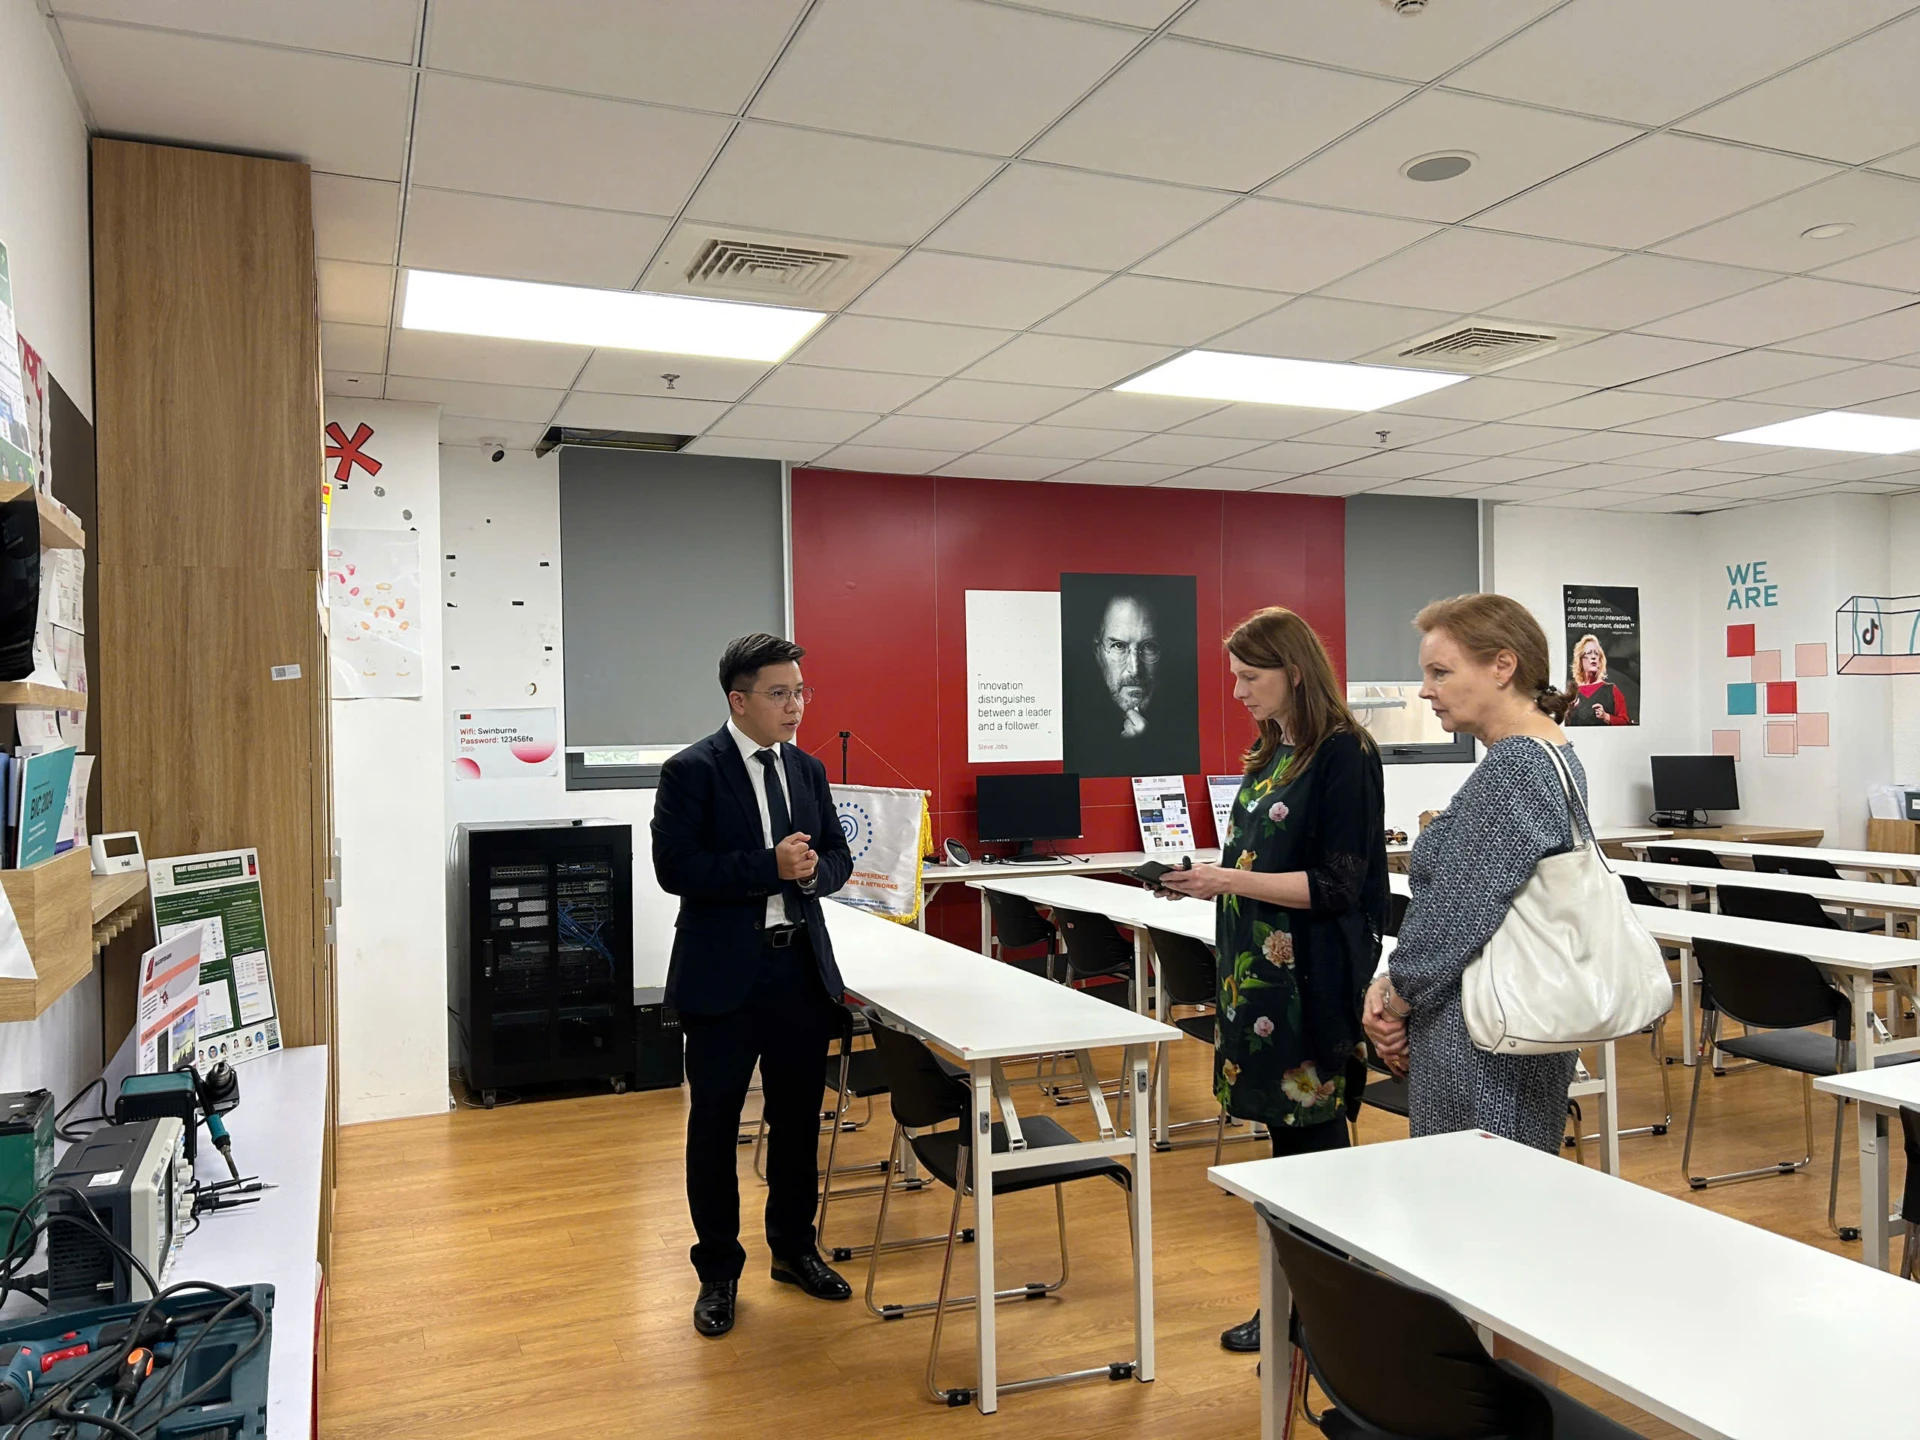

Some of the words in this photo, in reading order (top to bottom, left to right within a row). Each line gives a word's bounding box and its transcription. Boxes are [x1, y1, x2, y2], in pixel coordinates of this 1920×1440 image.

[1726, 561, 1767, 586] WE
[1727, 585, 1778, 610] ARE
[978, 680, 1023, 690] Innovation
[978, 694, 1036, 705] distinguishes
[978, 708, 1015, 717] between
[1026, 708, 1052, 717] leader
[978, 722, 994, 731] and
[1005, 722, 1040, 730] follower.
[852, 872, 889, 880] CONFERENCE
[866, 881, 898, 890] NETWORKS
